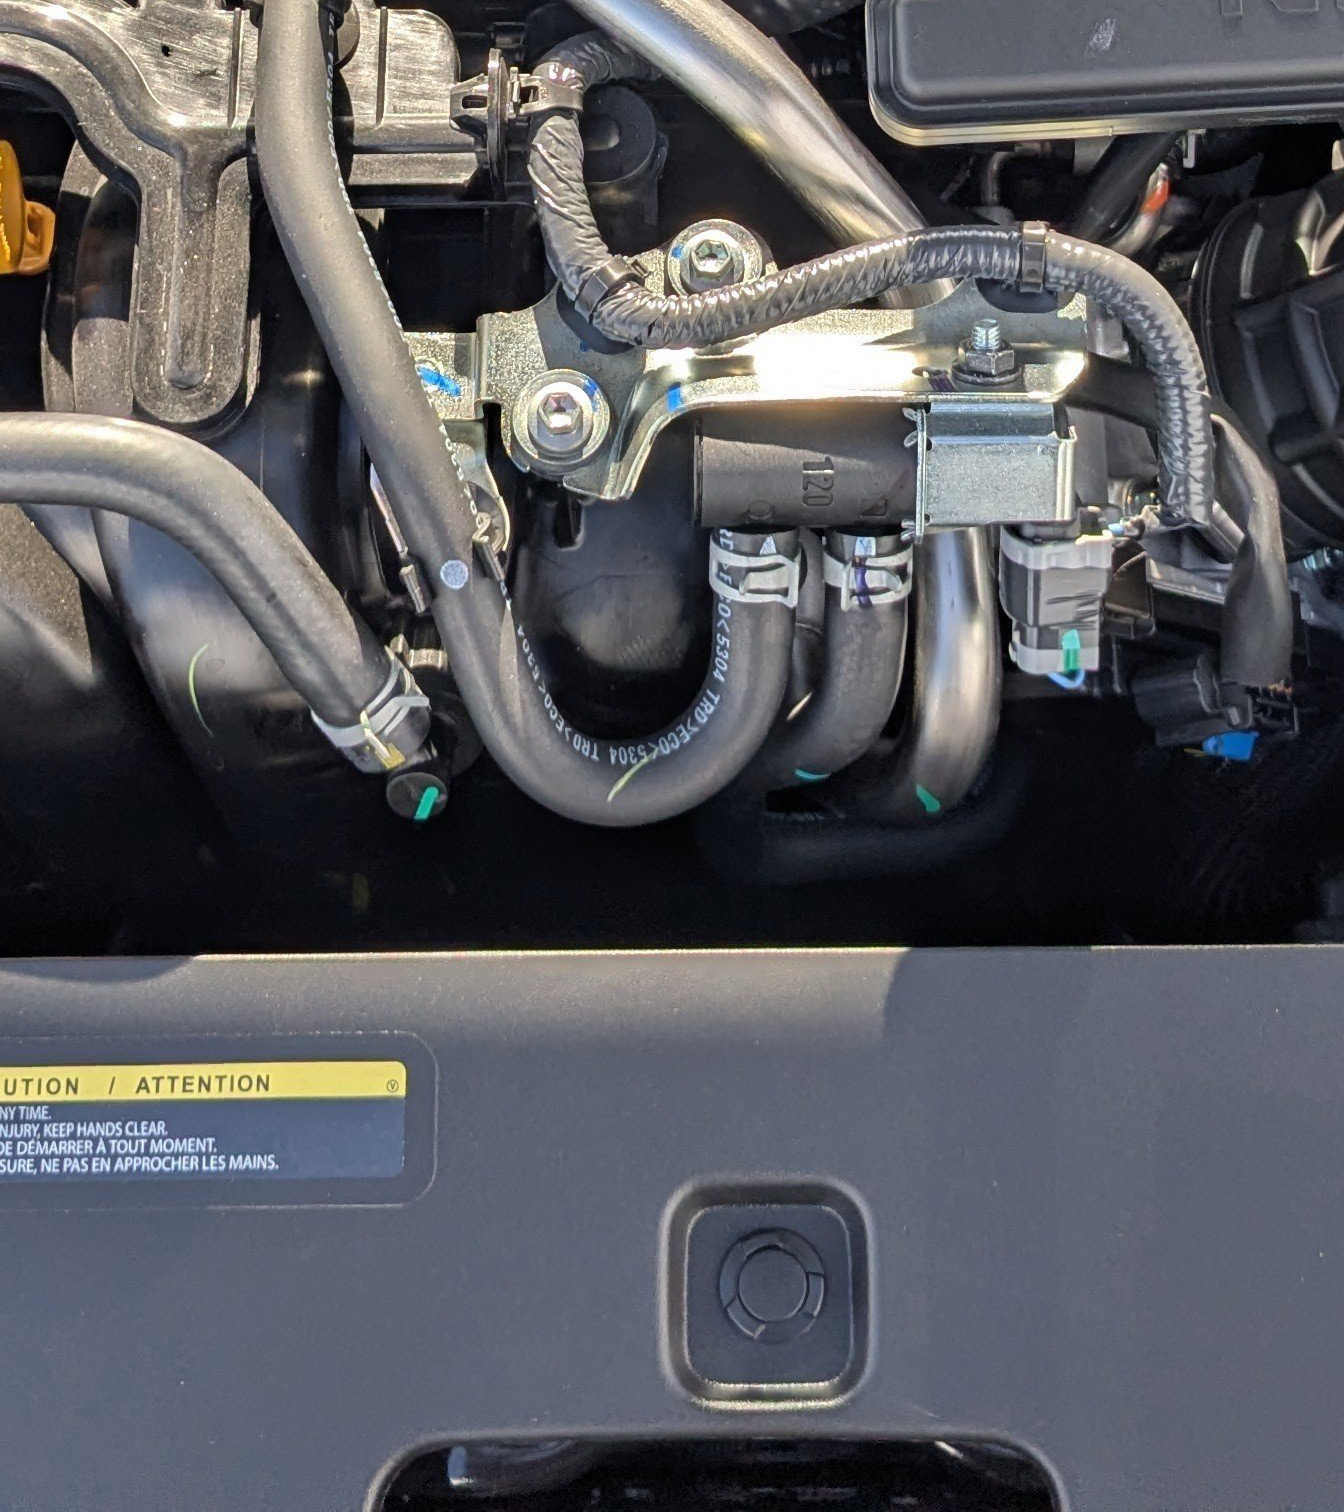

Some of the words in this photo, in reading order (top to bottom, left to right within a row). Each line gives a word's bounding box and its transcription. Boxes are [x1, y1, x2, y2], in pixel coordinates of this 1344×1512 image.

[802, 455, 835, 507] 120
[109, 1076, 117, 1095] /
[135, 1074, 271, 1095] ATTENTION
[19, 1105, 52, 1120] TIME.
[44, 1123, 75, 1138] KEEP
[77, 1122, 123, 1137] HANDS
[125, 1121, 168, 1136] CLEAR.
[17, 1138, 93, 1155] DÉMARRER
[95, 1136, 107, 1154] À
[109, 1140, 148, 1154] TOUT
[150, 1138, 217, 1153] MOMENT.
[41, 1158, 60, 1172] NE
[64, 1157, 90, 1172] PAS
[92, 1157, 112, 1172] EN
[113, 1156, 200, 1172] APPROCHER
[202, 1155, 226, 1170] LES
[229, 1154, 280, 1170] MAINS.
